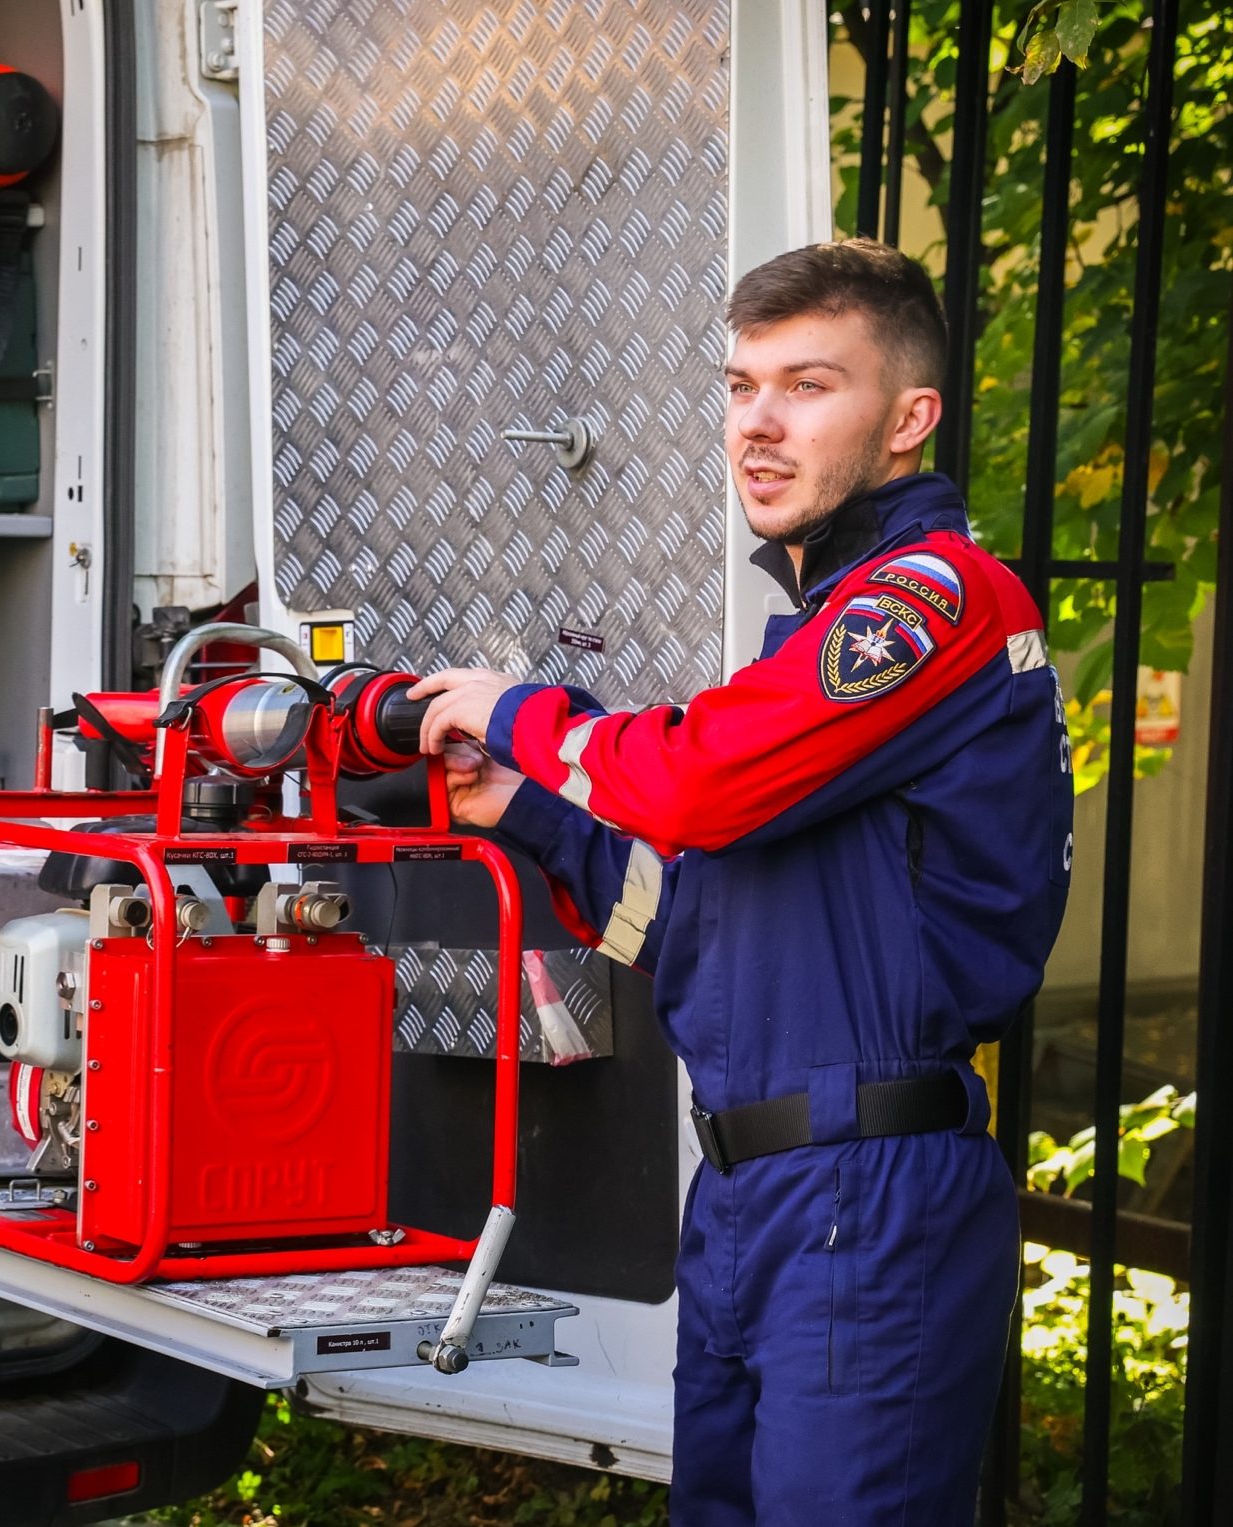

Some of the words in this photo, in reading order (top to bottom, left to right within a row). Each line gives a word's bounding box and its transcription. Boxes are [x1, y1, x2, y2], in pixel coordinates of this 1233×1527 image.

[885, 573, 948, 610] РОССИЯ
[879, 598, 918, 625] ВСКС
[198, 1159, 336, 1212] СПРУТ
[328, 1340, 352, 1348] Канистра
